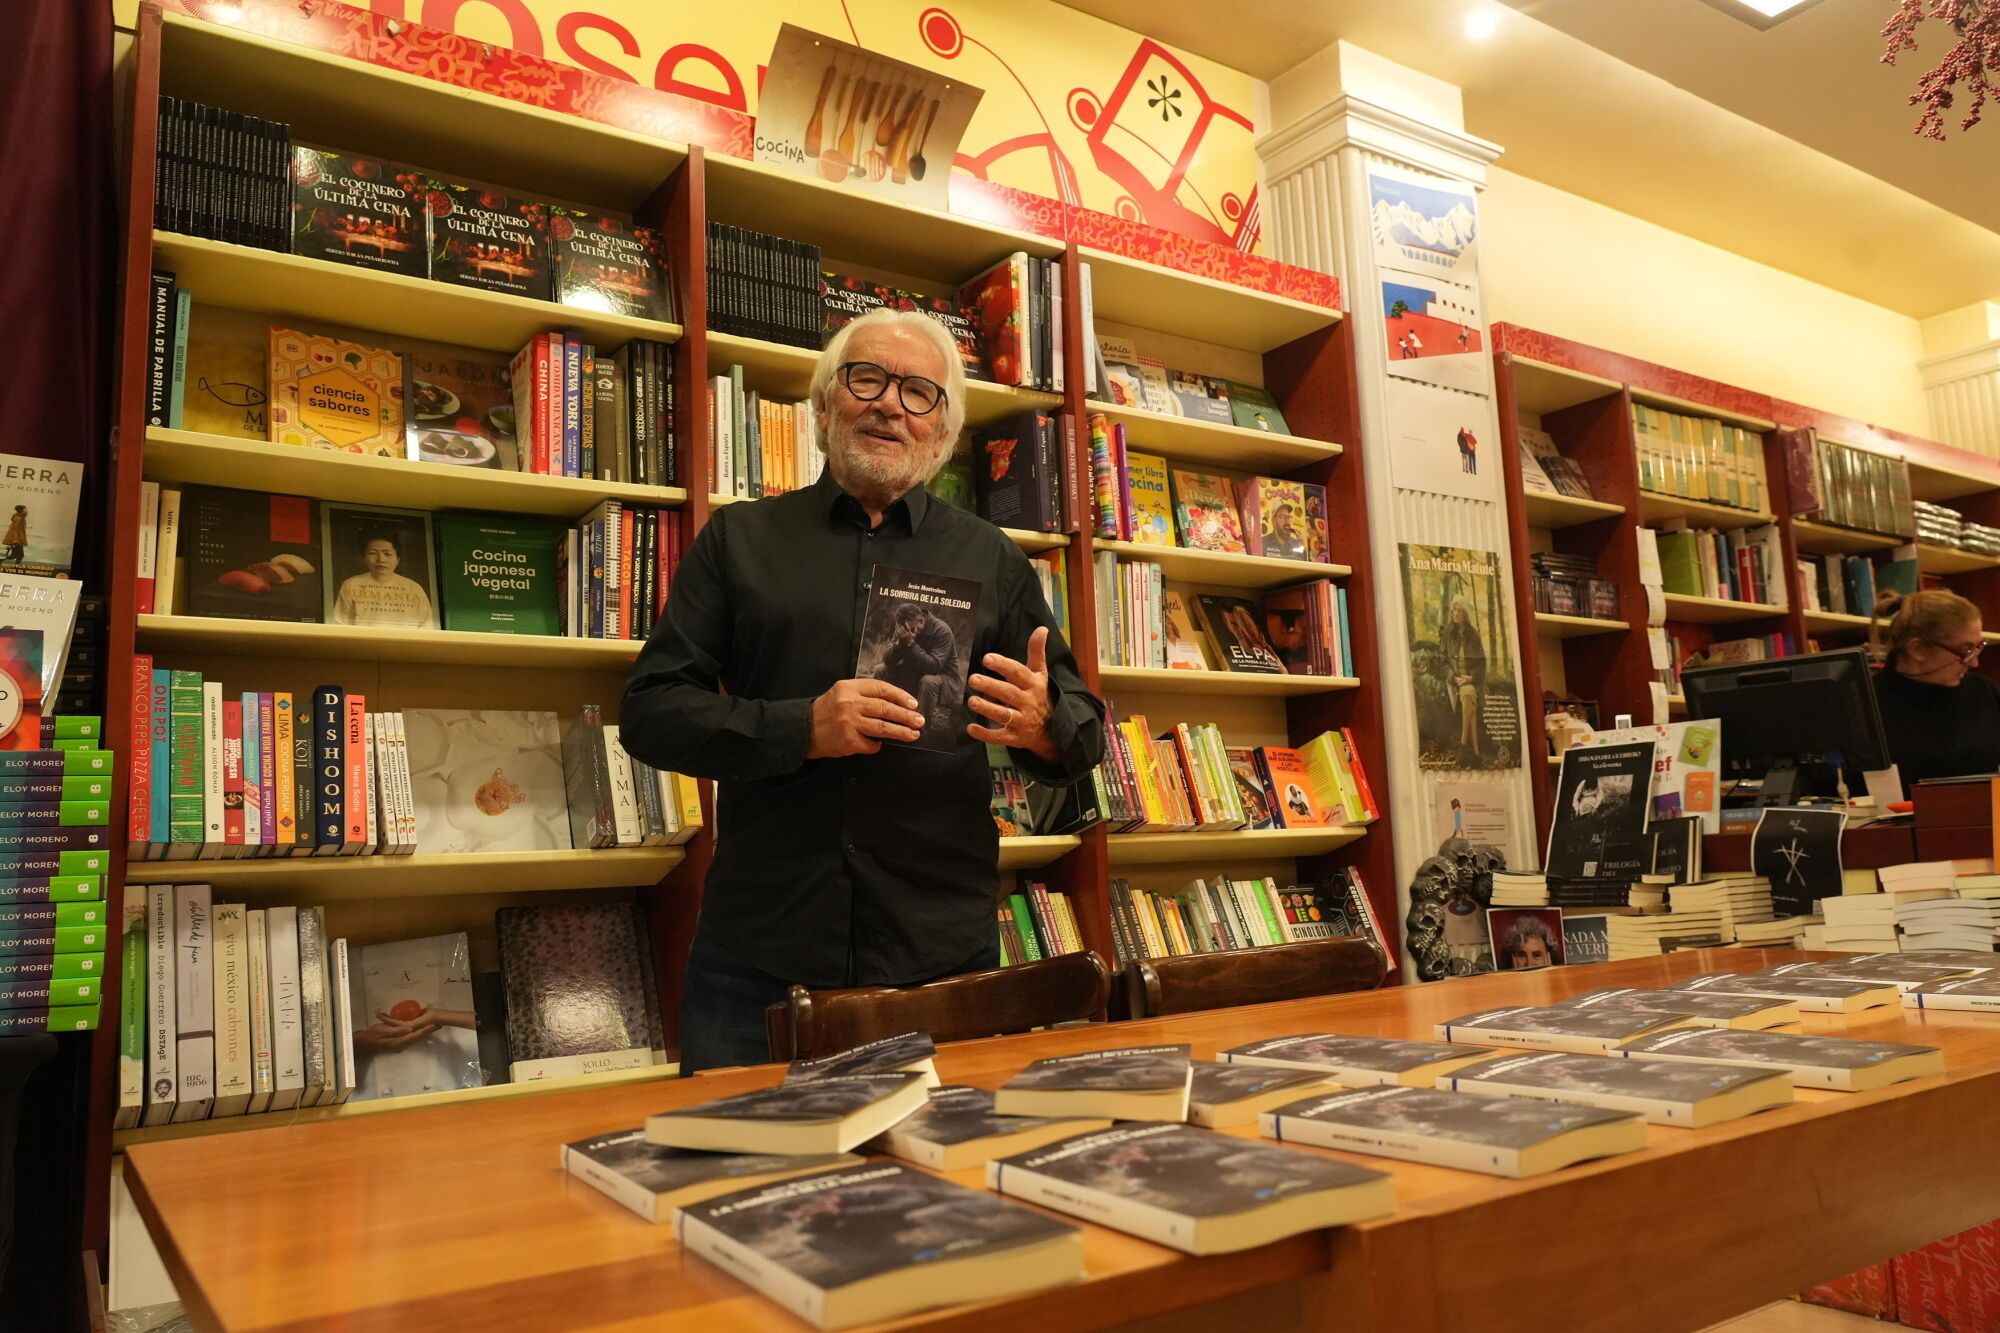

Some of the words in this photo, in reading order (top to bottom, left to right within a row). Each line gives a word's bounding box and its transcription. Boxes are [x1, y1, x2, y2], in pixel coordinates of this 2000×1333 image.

[321, 173, 337, 187] EL
[340, 178, 406, 199] COCINERO
[349, 188, 362, 197] DE
[314, 187, 369, 210] ÚLTIMA
[374, 201, 411, 218] CENA
[453, 204, 467, 215] EL
[470, 208, 530, 229] COCINERO
[478, 217, 491, 226] DE
[447, 217, 498, 239] ÚLTIMA
[500, 230, 536, 247] CENA
[574, 228, 588, 239] EL
[590, 233, 644, 253] COCINERO
[570, 240, 615, 260] ÚLTIMA
[619, 252, 650, 269] CENA
[155, 287, 168, 335] MANUAL
[840, 290, 884, 306] COCINERO
[928, 310, 969, 327] COCINERO
[154, 338, 165, 354] DE
[151, 357, 164, 412] PARRILLA
[539, 360, 549, 401] CHINA
[552, 359, 561, 404] COMIDA
[567, 351, 579, 392] NUEVA
[308, 396, 371, 417] sabores
[313, 384, 365, 403] ciencia
[567, 395, 578, 431] YORK
[552, 405, 561, 454] MEXICANA
[582, 414, 593, 449] ESPECIAS
[1145, 467, 1164, 479] libro
[17, 485, 62, 495] MORENO
[463, 561, 536, 577] japonesa
[472, 549, 527, 564] Cocina
[622, 550, 632, 586] TACOS
[1409, 556, 1431, 570] Ana
[1430, 557, 1461, 572] María
[1461, 560, 1495, 577] Matute
[471, 576, 530, 592] vegetal
[8, 605, 54, 614] MORENO
[879, 587, 889, 596] LA
[889, 588, 919, 601] SOMBRA
[920, 594, 930, 603] DE
[930, 596, 939, 605] LA
[940, 597, 971, 610] SOLEDAD
[1229, 645, 1254, 659] EL
[134, 658, 149, 714] FRANCO
[154, 685, 167, 712] ONE
[261, 706, 272, 734] FAMILIAR
[350, 701, 363, 716] La
[134, 716, 148, 745] PEPE
[154, 717, 167, 743] POT
[278, 713, 290, 739] LIMA
[350, 718, 361, 744] cena
[262, 736, 272, 753] INDIA
[280, 741, 290, 773] COCINA
[294, 738, 307, 768] KOJI
[324, 693, 341, 816] DISHOOM
[133, 747, 147, 785] PIZZA
[228, 738, 238, 779] JAPONESA
[262, 755, 272, 778] COCINA
[612, 735, 630, 807] ANIMA
[281, 775, 291, 813] PERUANA
[24, 861, 59, 869] MOREN
[23, 912, 57, 920] MOREN
[157, 893, 165, 950] irreductible
[23, 938, 55, 946] MOREN
[225, 933, 237, 956] viva
[1576, 942, 1607, 955] VERI
[156, 955, 166, 980] Diego
[226, 960, 240, 1004] méxico
[157, 984, 166, 1024] Guerrero
[227, 1007, 241, 1063] cabrones
